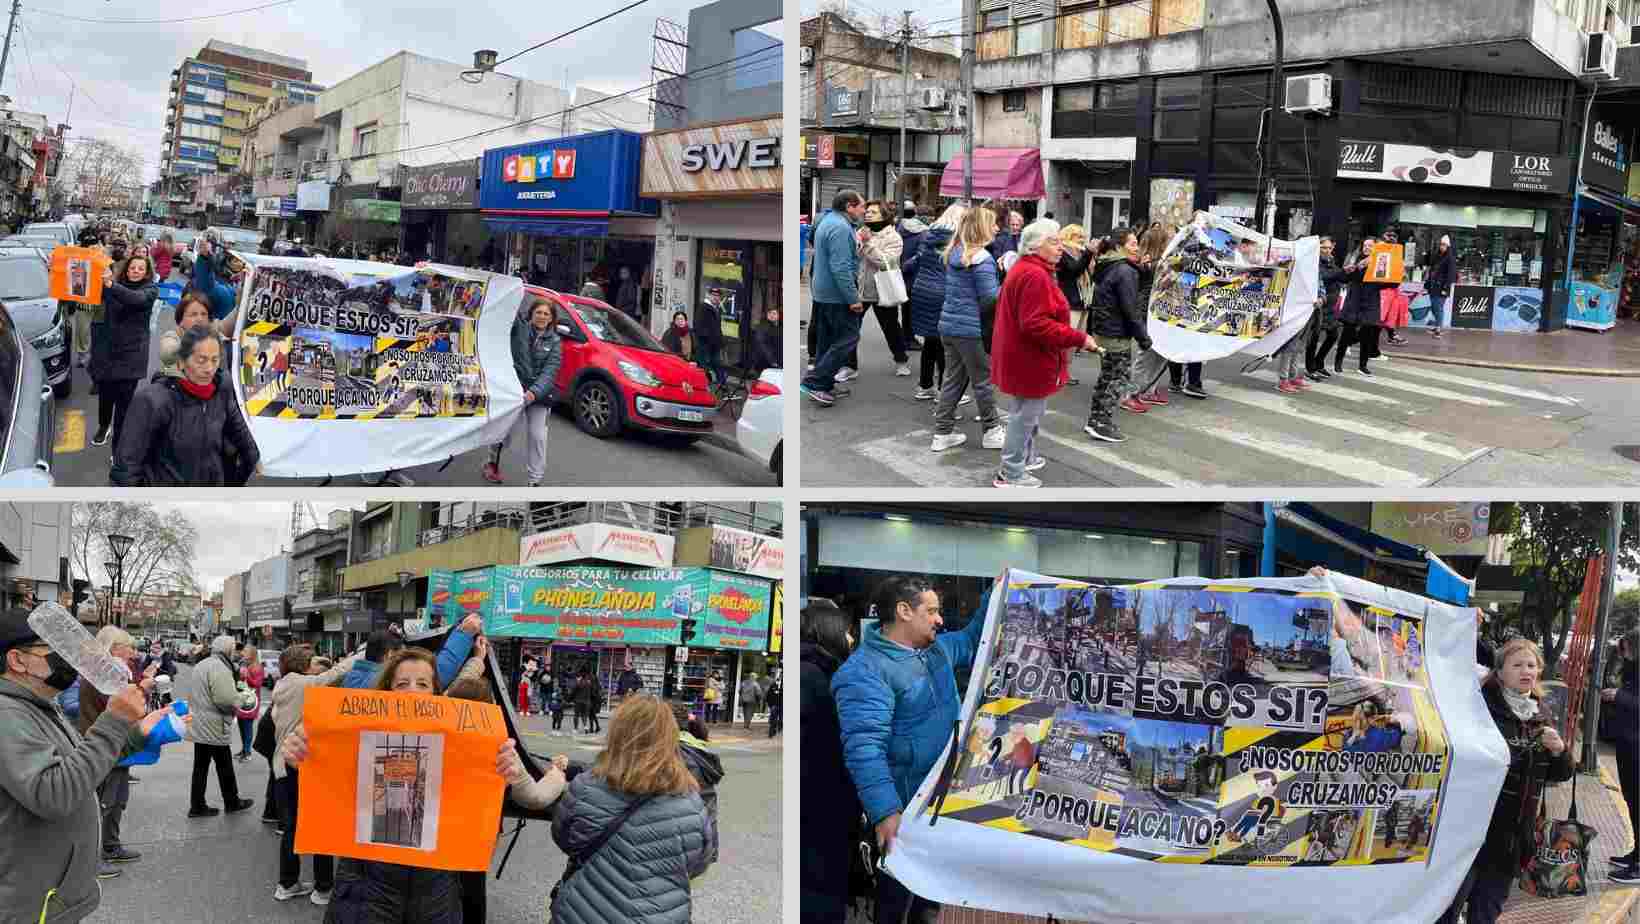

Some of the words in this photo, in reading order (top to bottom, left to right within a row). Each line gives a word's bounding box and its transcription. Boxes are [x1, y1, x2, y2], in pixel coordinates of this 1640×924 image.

[682, 137, 783, 172] SWE
[1512, 154, 1552, 171] LOR
[249, 294, 331, 326] ¿PORQUE
[336, 307, 391, 334] ESTOS
[985, 661, 1124, 707] ¿PORQUE
[1134, 676, 1257, 718] ESTOS
[1267, 685, 1328, 727] SI?
[1238, 745, 1353, 773] ¿NOSOTROS
[1354, 751, 1388, 774] POR
[1389, 752, 1443, 774] DONDE
[1286, 781, 1398, 806] CRUZAMOS?
[1014, 789, 1120, 833] ¿PORQUE
[1120, 807, 1172, 843] ACA
[1175, 814, 1227, 847] NO?
